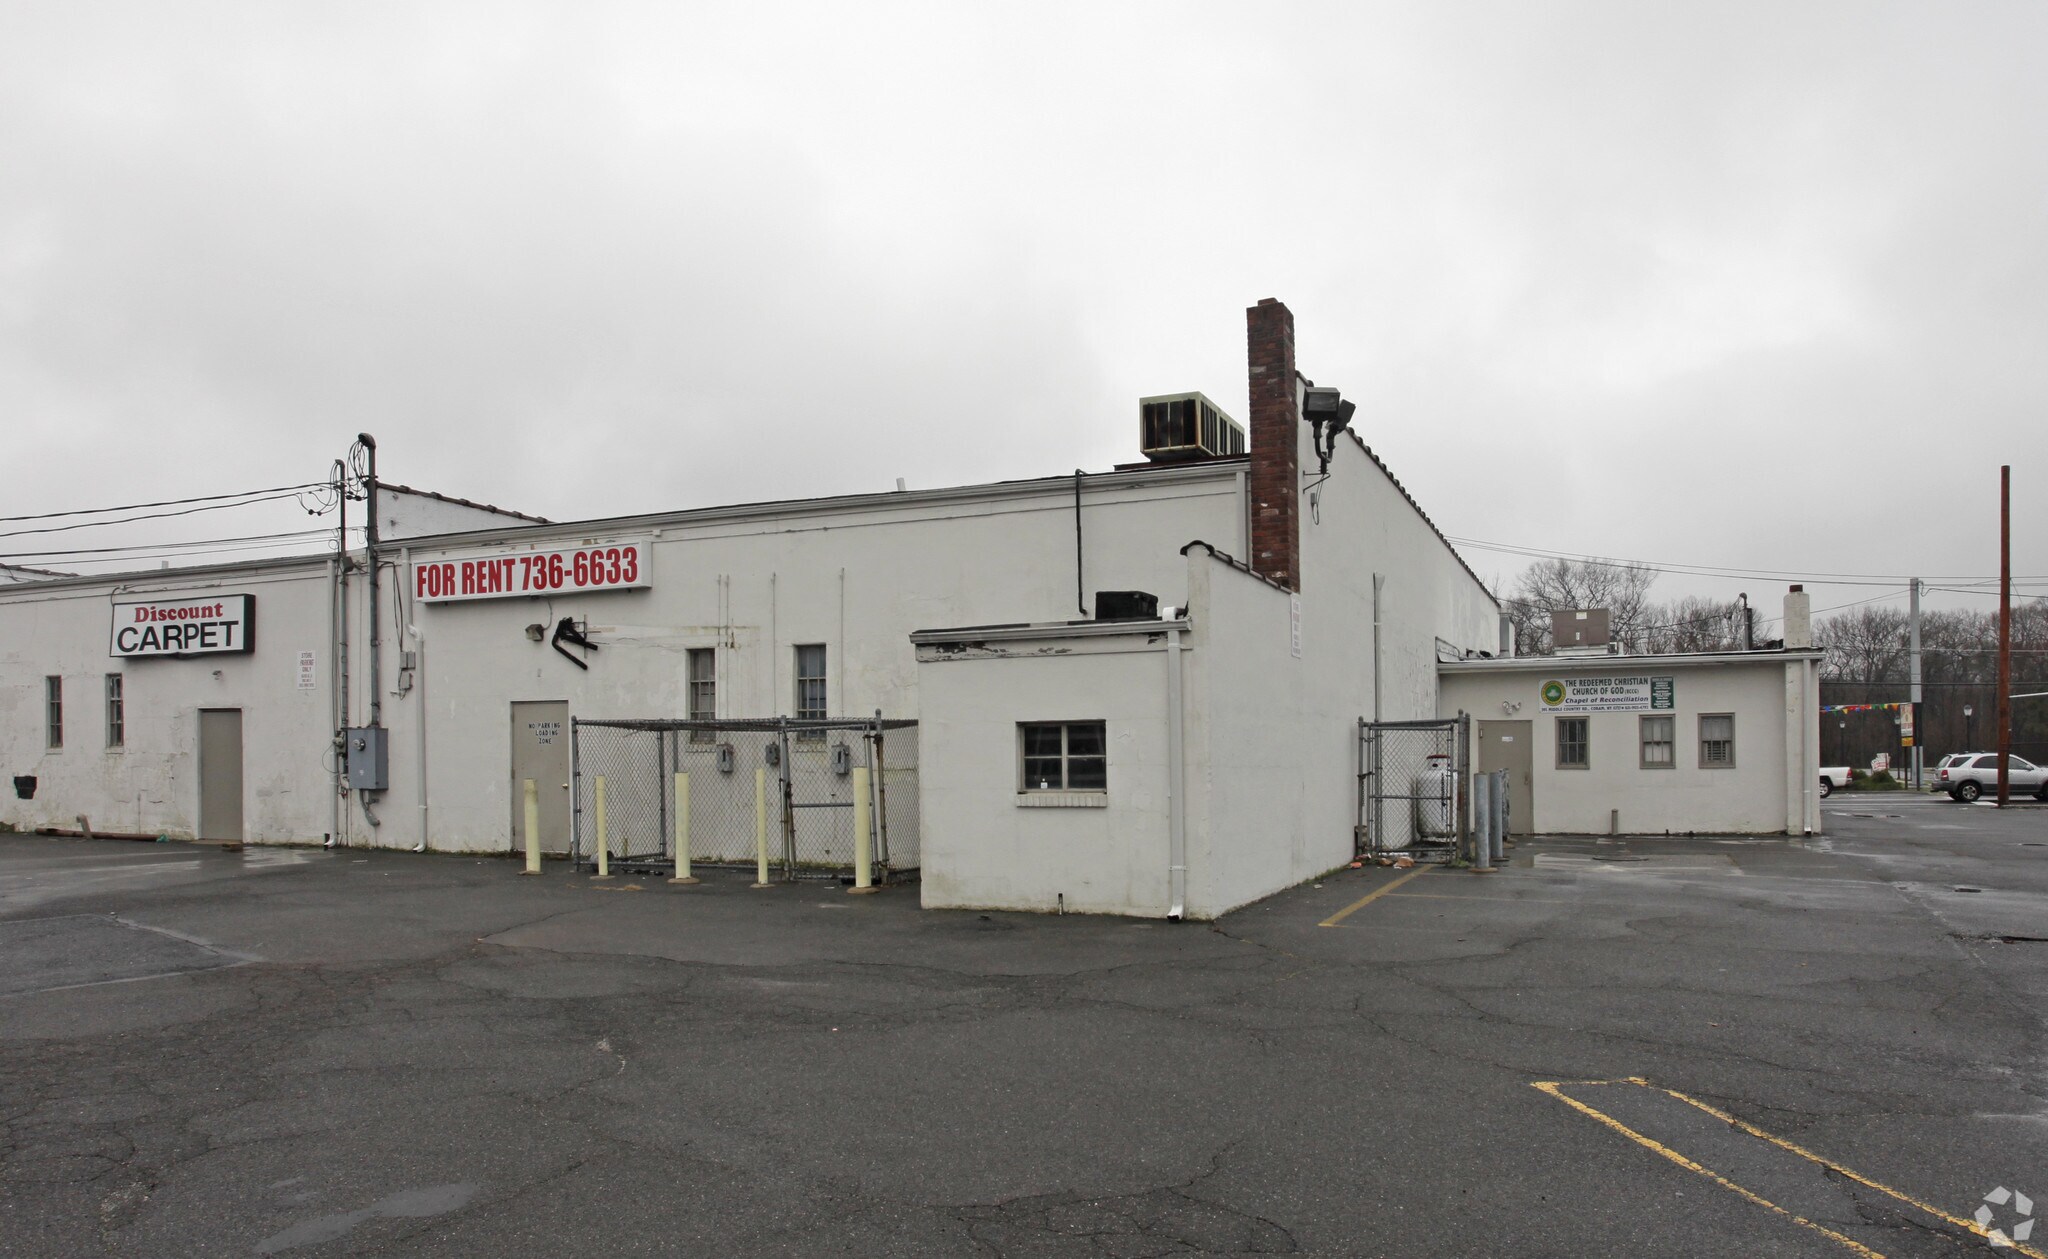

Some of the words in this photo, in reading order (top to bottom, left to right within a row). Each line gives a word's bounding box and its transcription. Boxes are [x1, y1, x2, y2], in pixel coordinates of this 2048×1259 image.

[417, 563, 456, 598] FOR
[462, 558, 516, 595] RENT
[520, 546, 638, 592] 736-6633
[134, 602, 224, 623] Discount
[117, 620, 240, 653] CARPET
[1565, 679, 1577, 688] THE
[1579, 679, 1613, 687] REDEEMED
[1614, 677, 1649, 686] CHRISTIAN
[1572, 687, 1599, 696] CHURCH
[1600, 687, 1608, 695] OF
[1610, 686, 1624, 695] GOD
[1565, 697, 1589, 705] Chapel
[538, 737, 552, 745] ZONE
